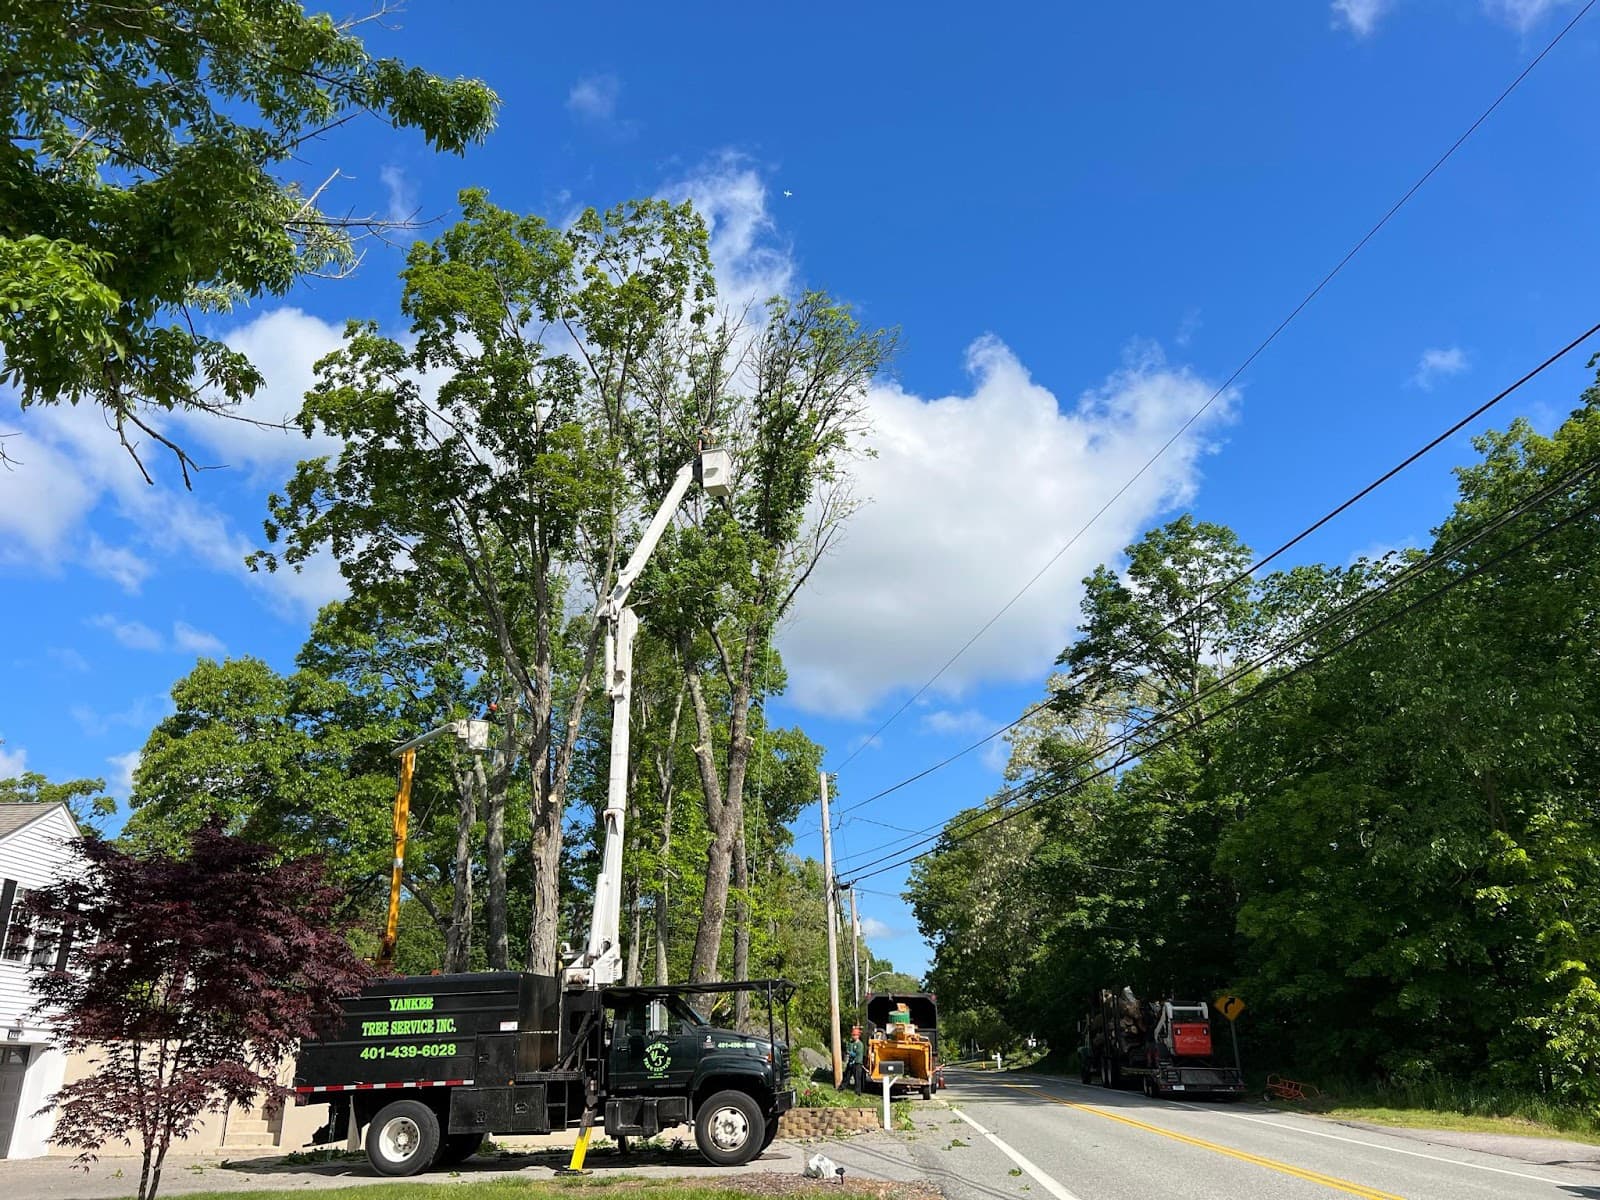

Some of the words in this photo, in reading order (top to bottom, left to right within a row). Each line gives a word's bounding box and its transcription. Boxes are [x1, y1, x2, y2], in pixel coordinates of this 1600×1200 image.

[389, 996, 434, 1012] YANKEE
[361, 1020, 389, 1037] TREE
[390, 1018, 435, 1036] SERVICE
[435, 1017, 457, 1034] INC.
[360, 1043, 457, 1060] 401-439-6028
